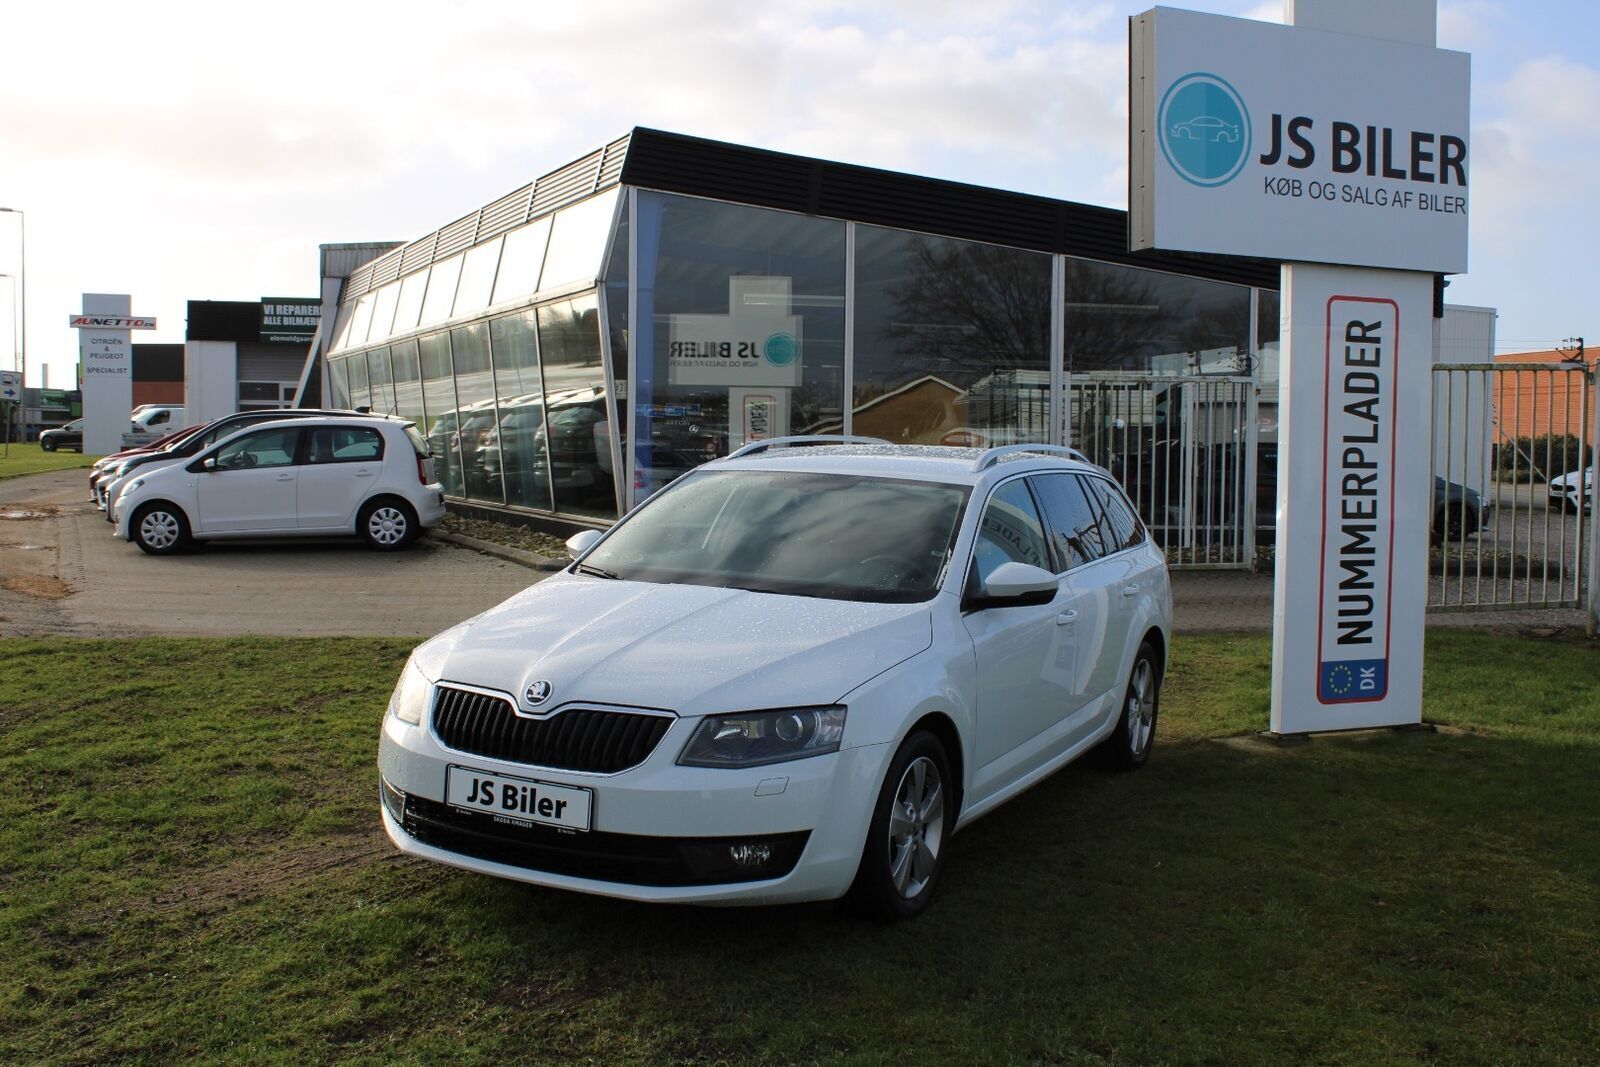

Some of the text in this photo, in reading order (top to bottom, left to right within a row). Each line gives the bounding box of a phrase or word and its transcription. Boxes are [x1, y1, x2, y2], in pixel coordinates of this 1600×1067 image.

[1259, 113, 1467, 187] JS BILER
[1264, 175, 1466, 214] KØB OG SALG AF BILER
[263, 304, 321, 316] VI REPARER
[263, 316, 282, 325] ALLE
[1337, 319, 1382, 645] NUMMERPLADER
[1359, 665, 1375, 691] DK
[466, 778, 567, 819] JS Biler
